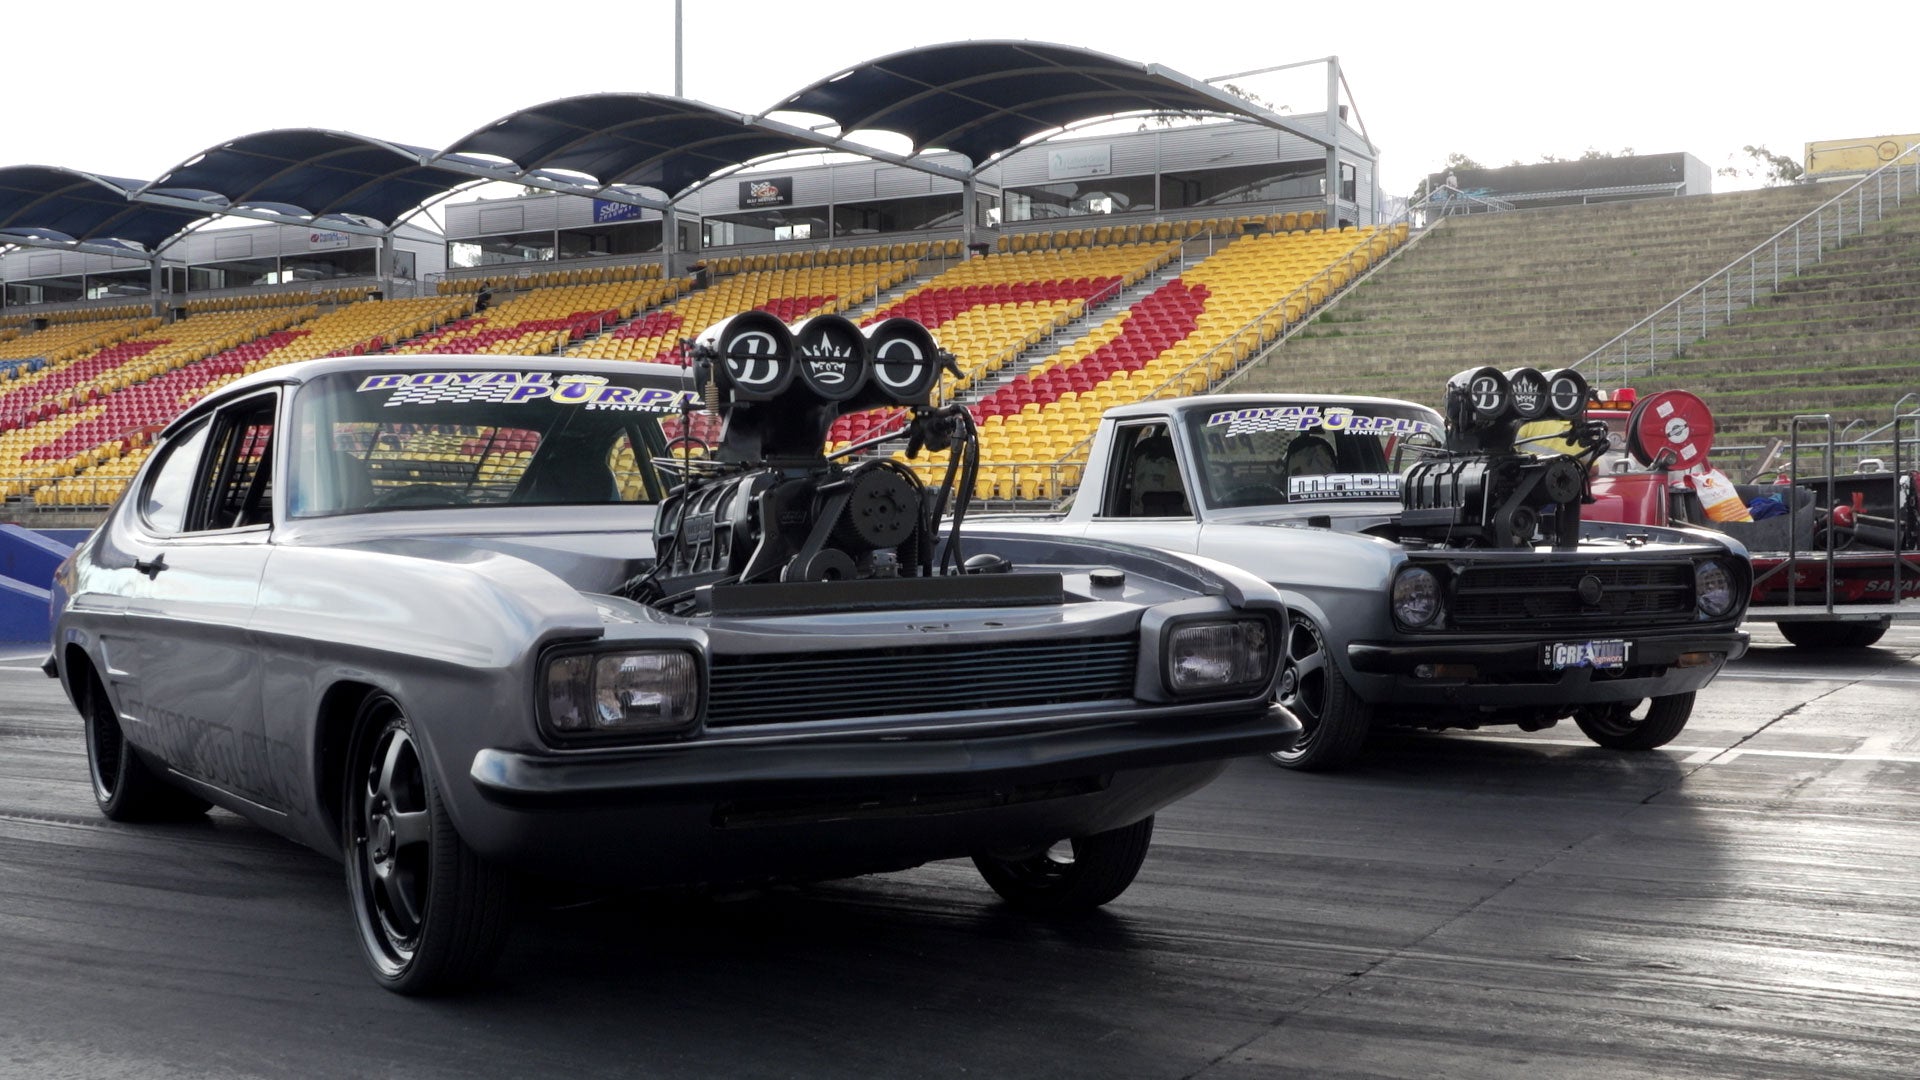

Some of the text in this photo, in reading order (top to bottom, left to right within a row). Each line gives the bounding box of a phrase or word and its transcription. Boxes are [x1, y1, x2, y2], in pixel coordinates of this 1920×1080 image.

[727, 331, 924, 387] B O
[356, 371, 553, 393] ROYAL
[1551, 378, 1578, 411] O
[1206, 406, 1320, 428] ROYAL
[1295, 410, 1431, 434] PURPLE
